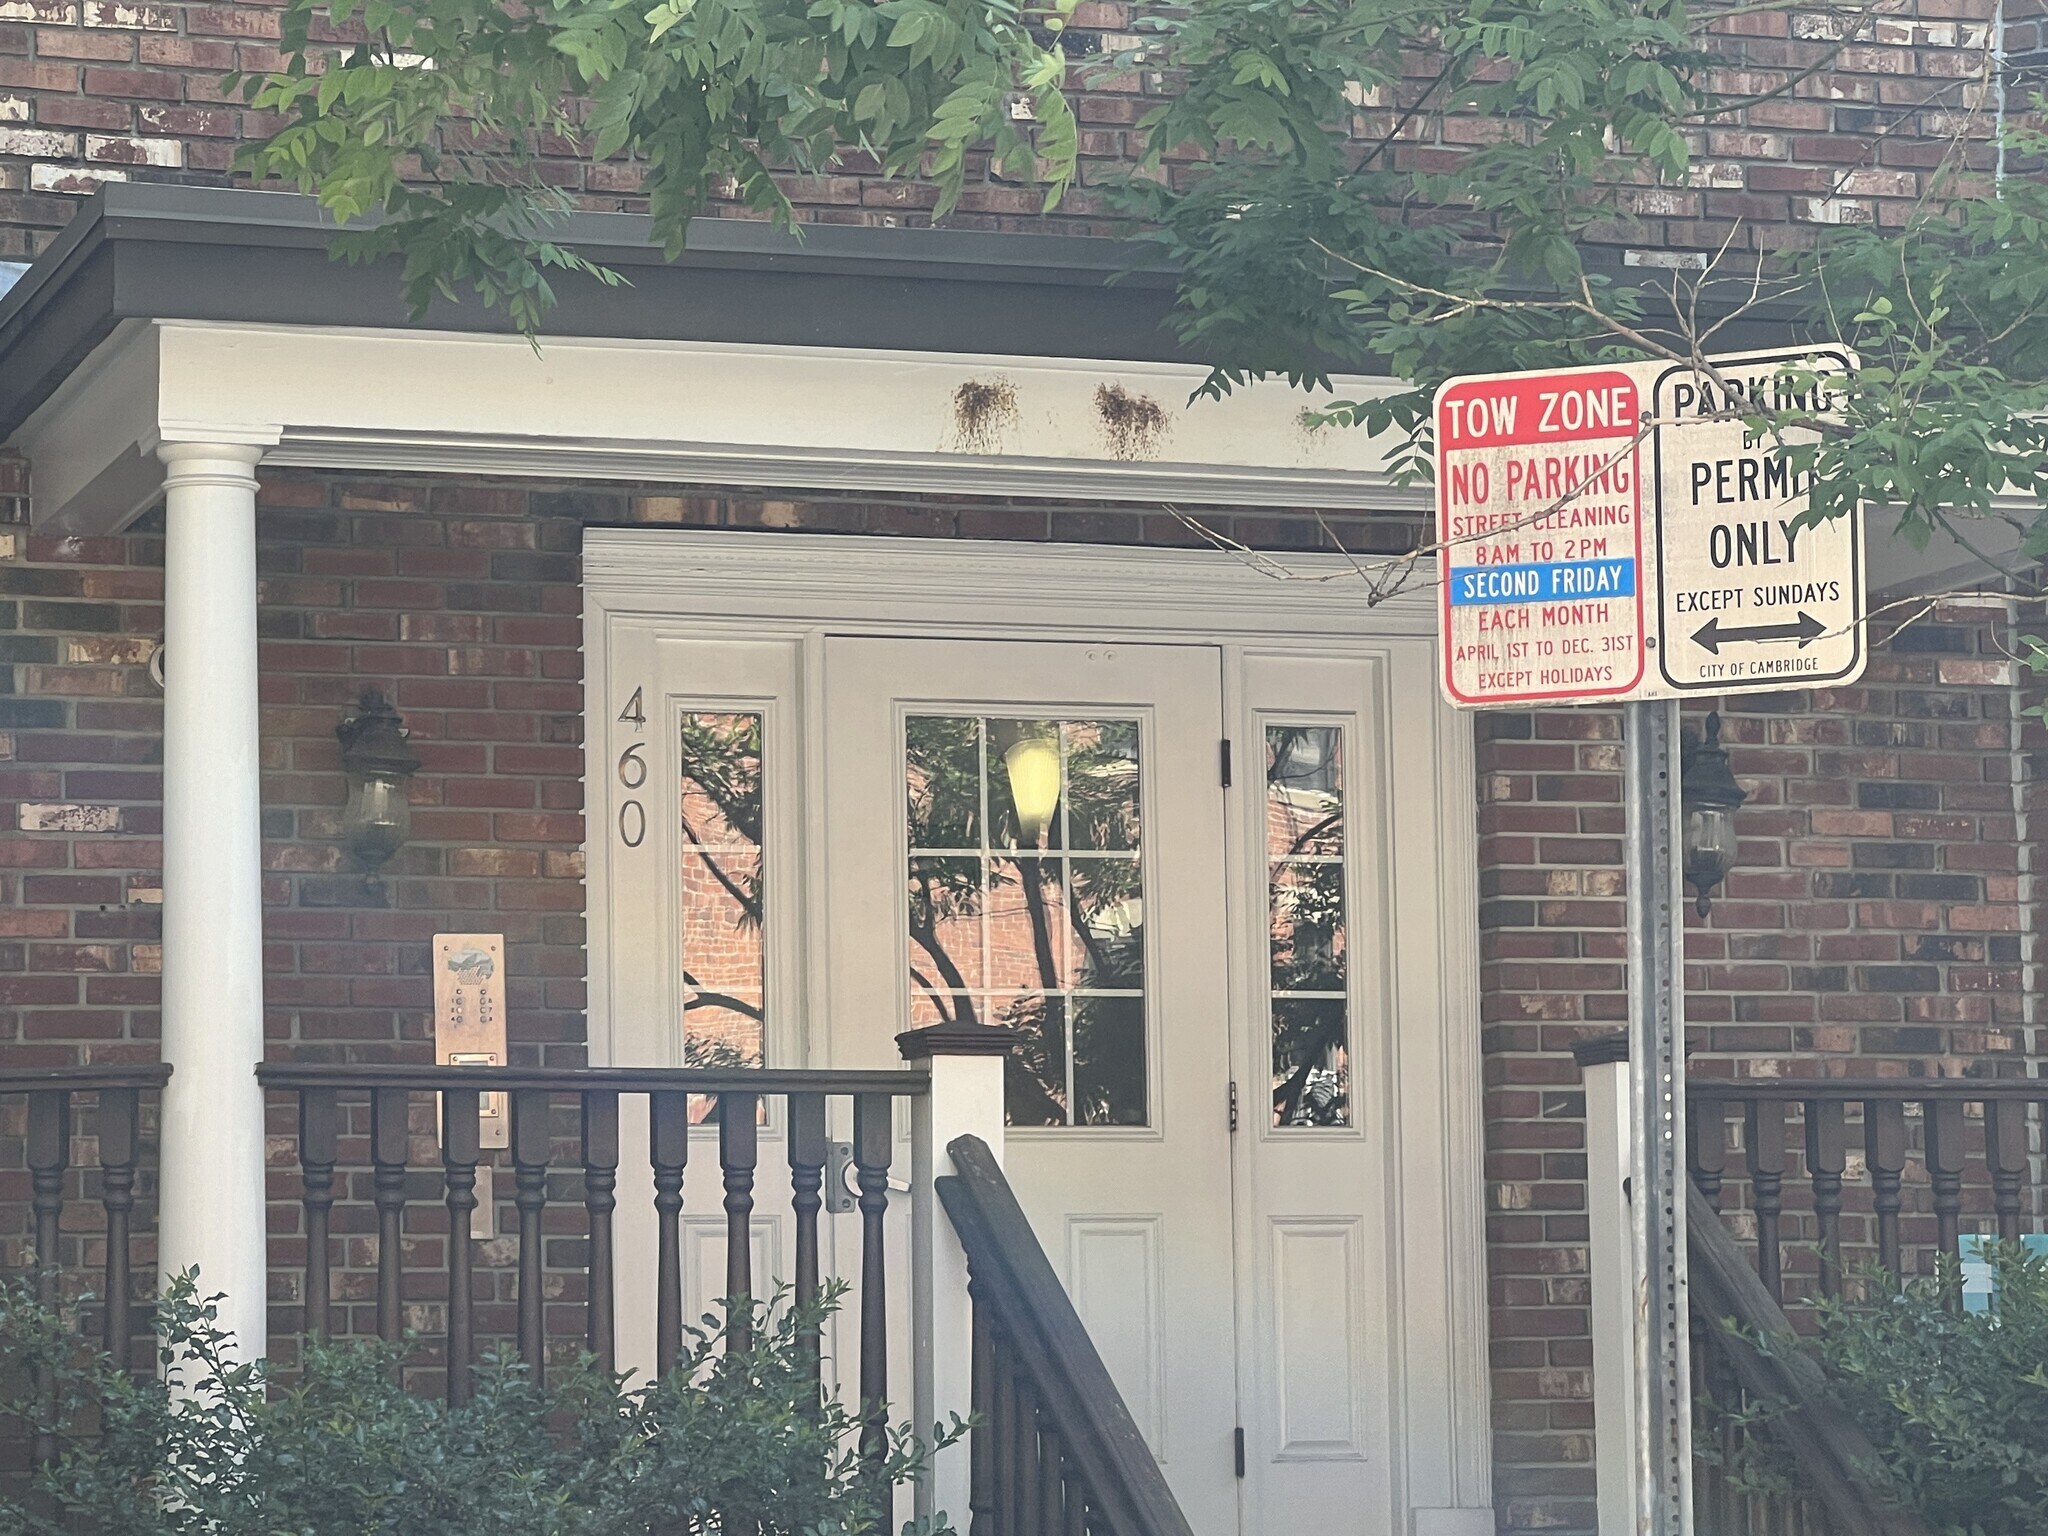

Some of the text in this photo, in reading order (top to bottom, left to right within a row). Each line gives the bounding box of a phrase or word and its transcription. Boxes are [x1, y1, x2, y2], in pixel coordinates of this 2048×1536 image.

[1445, 386, 1633, 440] TOW ZONE
[1452, 453, 1630, 506] NO PARKING
[1453, 504, 1630, 537] STREET CLEANING
[1476, 537, 1607, 566] 8AM TO 2PM
[1709, 520, 1801, 569] ONLY
[1463, 565, 1622, 599] SECOND FRIDAY
[1676, 581, 1841, 613] EXCEPT SUNDAYS
[1478, 603, 1609, 632] EACH MONTH
[1456, 635, 1633, 661] APRIL 1ST TO DEC. 31ST
[1478, 665, 1613, 689] EXCEPT HOLIDAYS
[1699, 657, 1819, 678] CITY OF CAMBRIDGE
